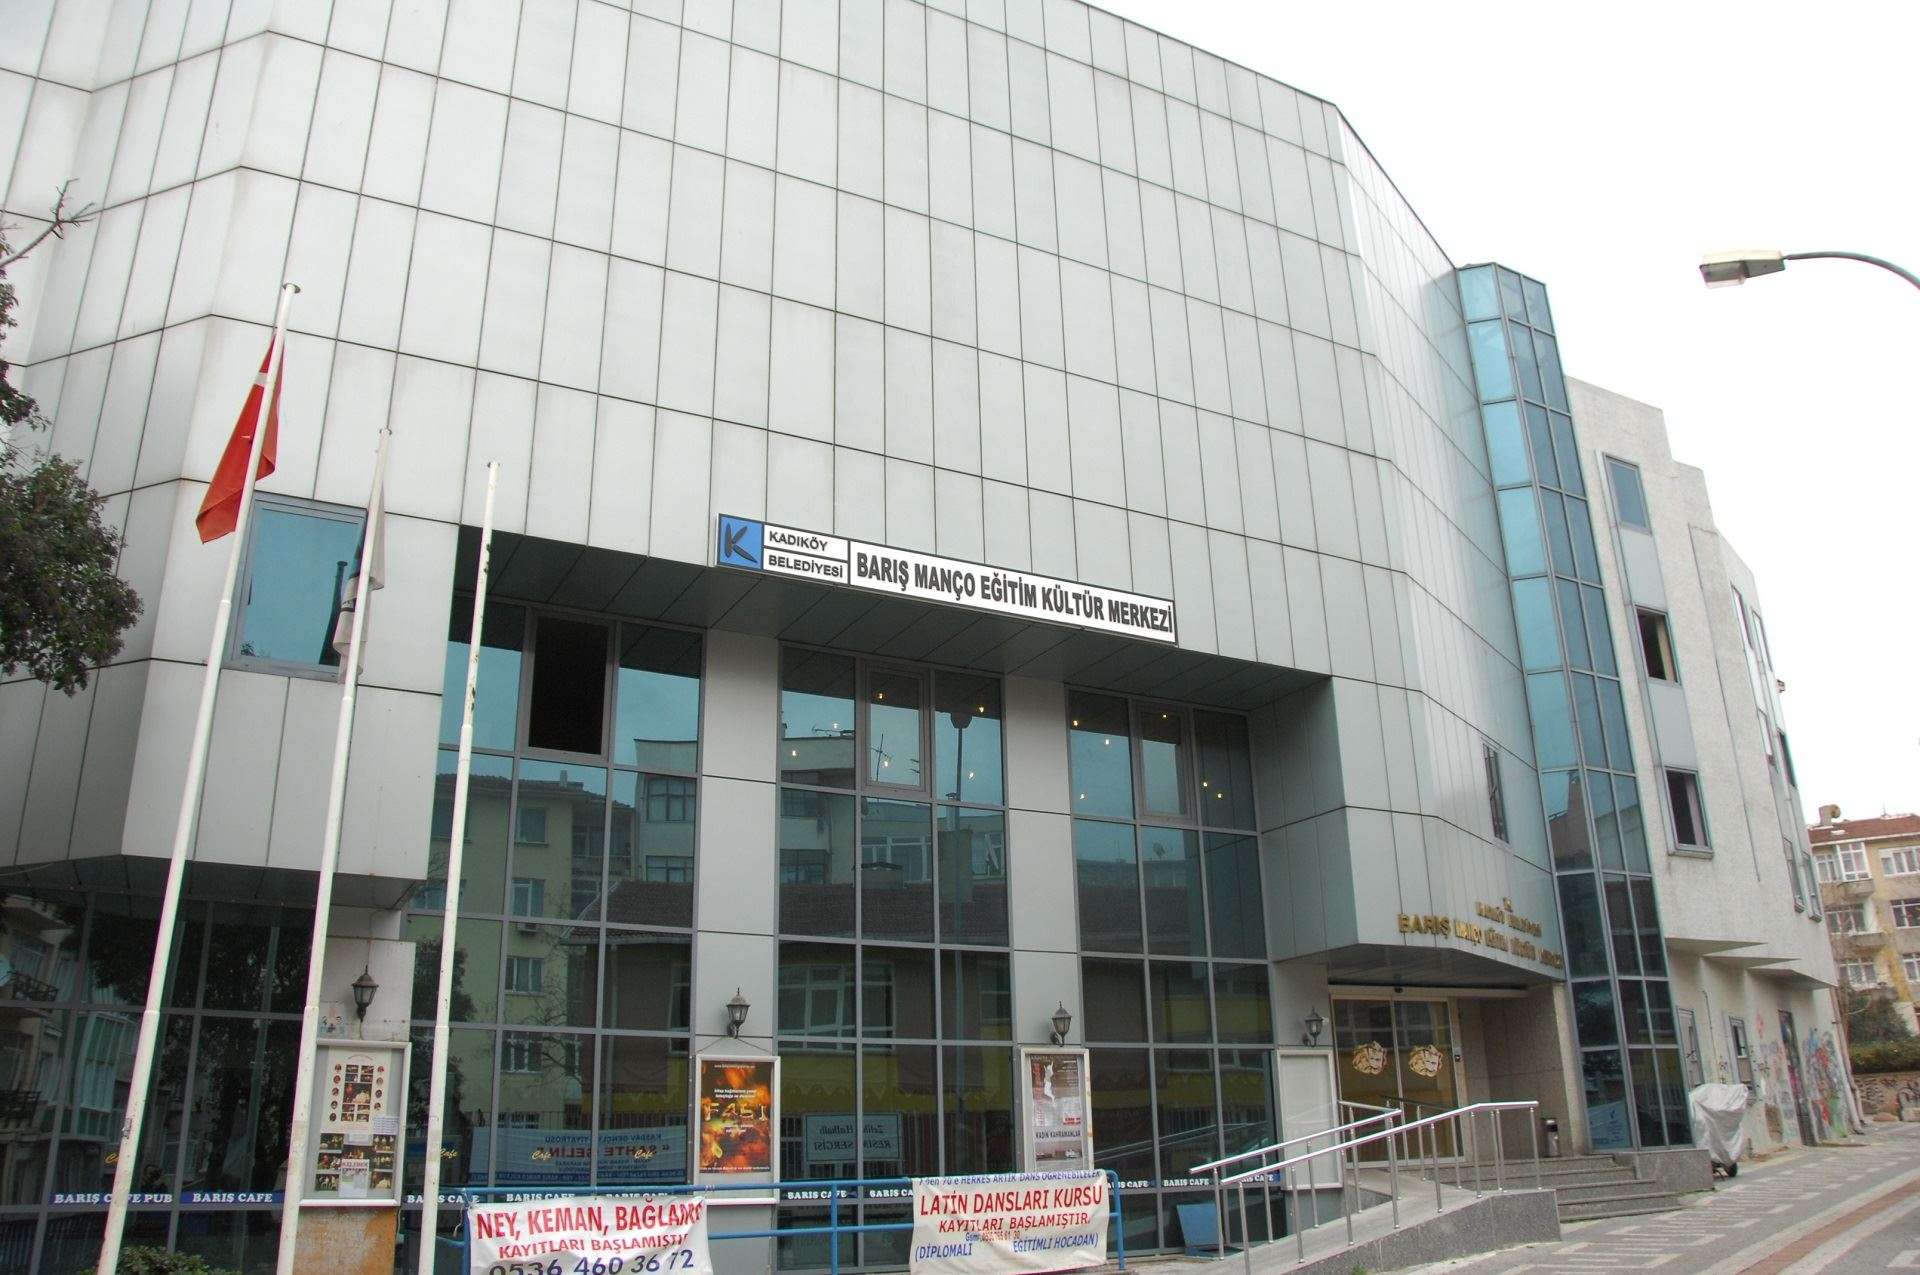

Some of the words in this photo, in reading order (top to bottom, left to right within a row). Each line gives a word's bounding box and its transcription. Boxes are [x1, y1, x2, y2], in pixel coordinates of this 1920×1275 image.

[769, 530, 828, 552] KADIKÖY
[768, 555, 844, 578] BELEDİYESİ
[857, 552, 909, 591] BARIŞ
[914, 563, 976, 601] MANÇO
[981, 571, 1037, 608] EĞİTİM
[1041, 584, 1105, 621] KÜLTÜR
[1108, 604, 1173, 633] MERKEZİ
[1398, 913, 1450, 939] BARIŞ
[1189, 1178, 1210, 1186] CAFE
[54, 1194, 100, 1204] BARIŞ
[103, 1194, 141, 1203] CFE
[143, 1194, 173, 1203] PUB
[238, 1193, 273, 1203] CAFE
[920, 1190, 968, 1216] LATİN
[973, 1189, 1049, 1214] DANSLARI
[1053, 1185, 1103, 1208] KURSU
[476, 1211, 520, 1240] NEY,
[527, 1206, 609, 1236] KEMAN,
[939, 1218, 1004, 1233] KAYITLARI
[499, 1239, 585, 1259] KAYITLARI
[1054, 1231, 1099, 1249] HOCADAN)
[573, 1256, 624, 1275] 460
[630, 1253, 660, 1273] 36
